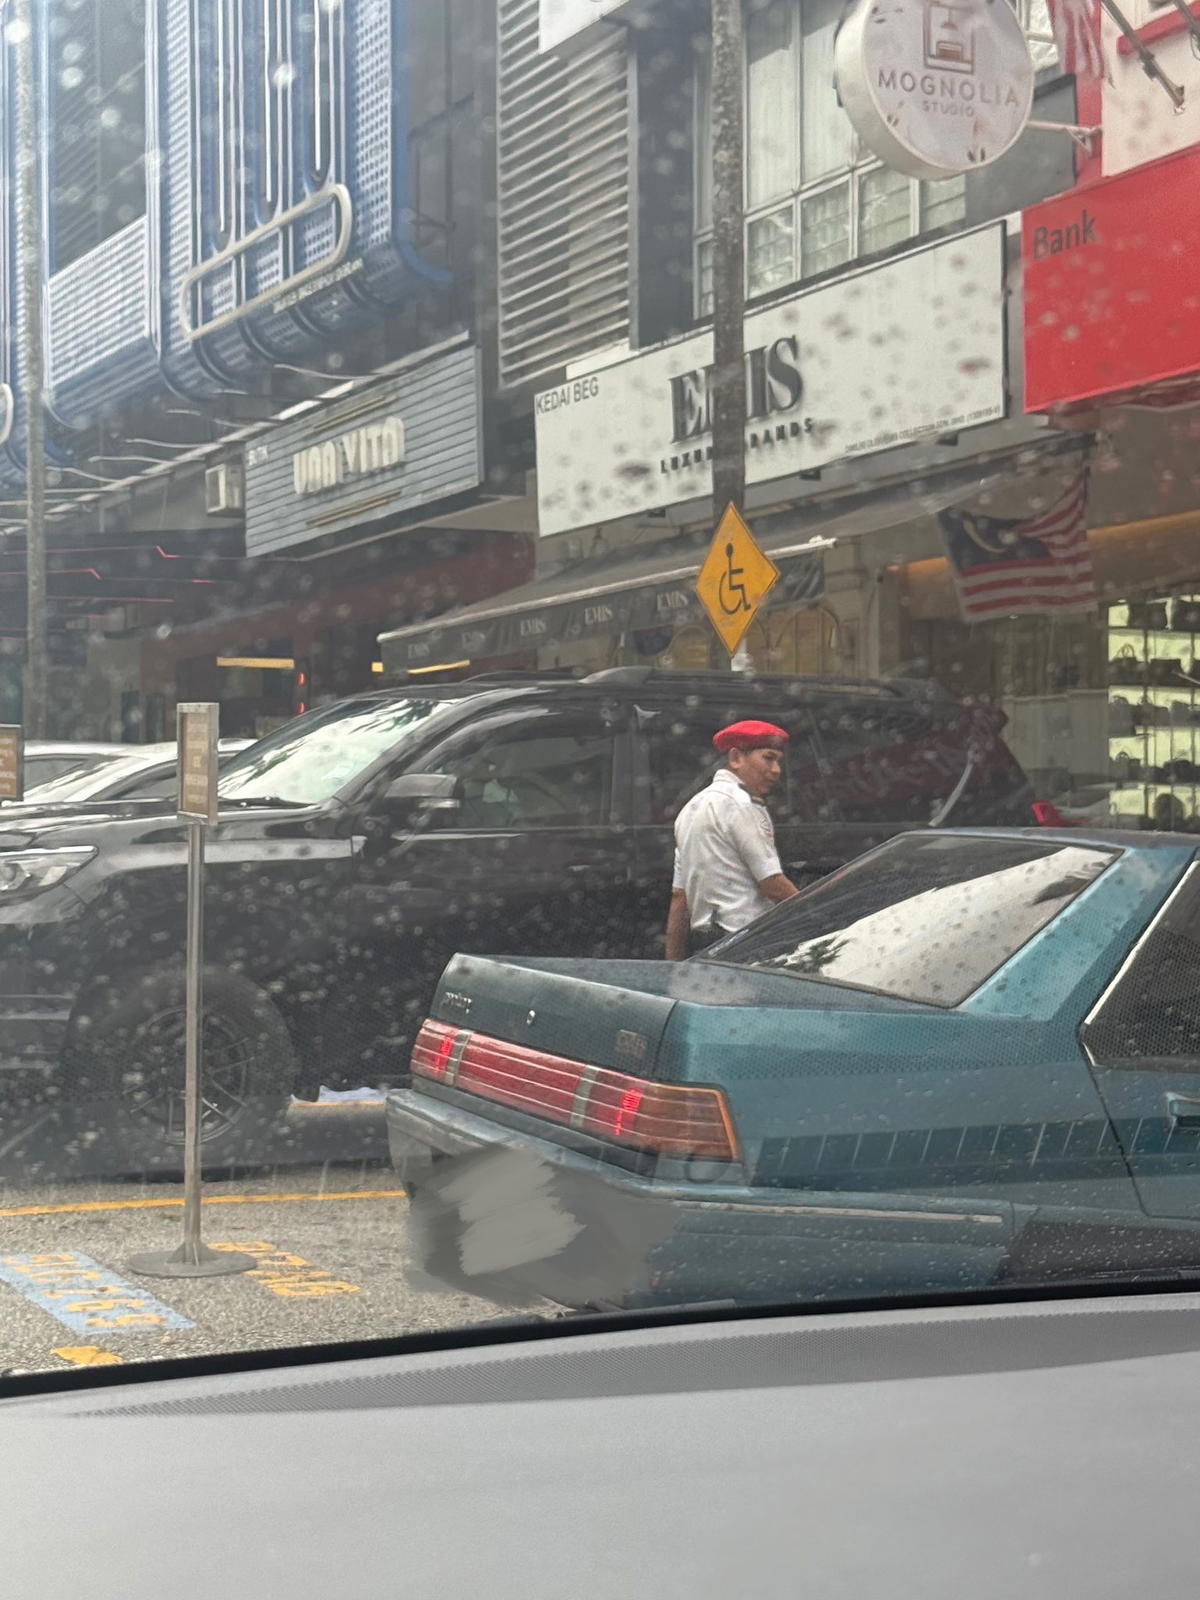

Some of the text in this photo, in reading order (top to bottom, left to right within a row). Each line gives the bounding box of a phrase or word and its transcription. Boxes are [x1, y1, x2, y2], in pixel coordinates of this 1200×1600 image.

[878, 68, 1019, 107] MOGNOLIA
[922, 101, 975, 117] STUDIO
[1034, 209, 1096, 259] Bank
[535, 376, 599, 415] KEDAI BEG
[669, 335, 803, 443] EIS
[343, 416, 405, 474] VITA
[660, 446, 714, 474] LUXUR
[749, 417, 813, 449] RANDS
[584, 606, 614, 625] EMIS
